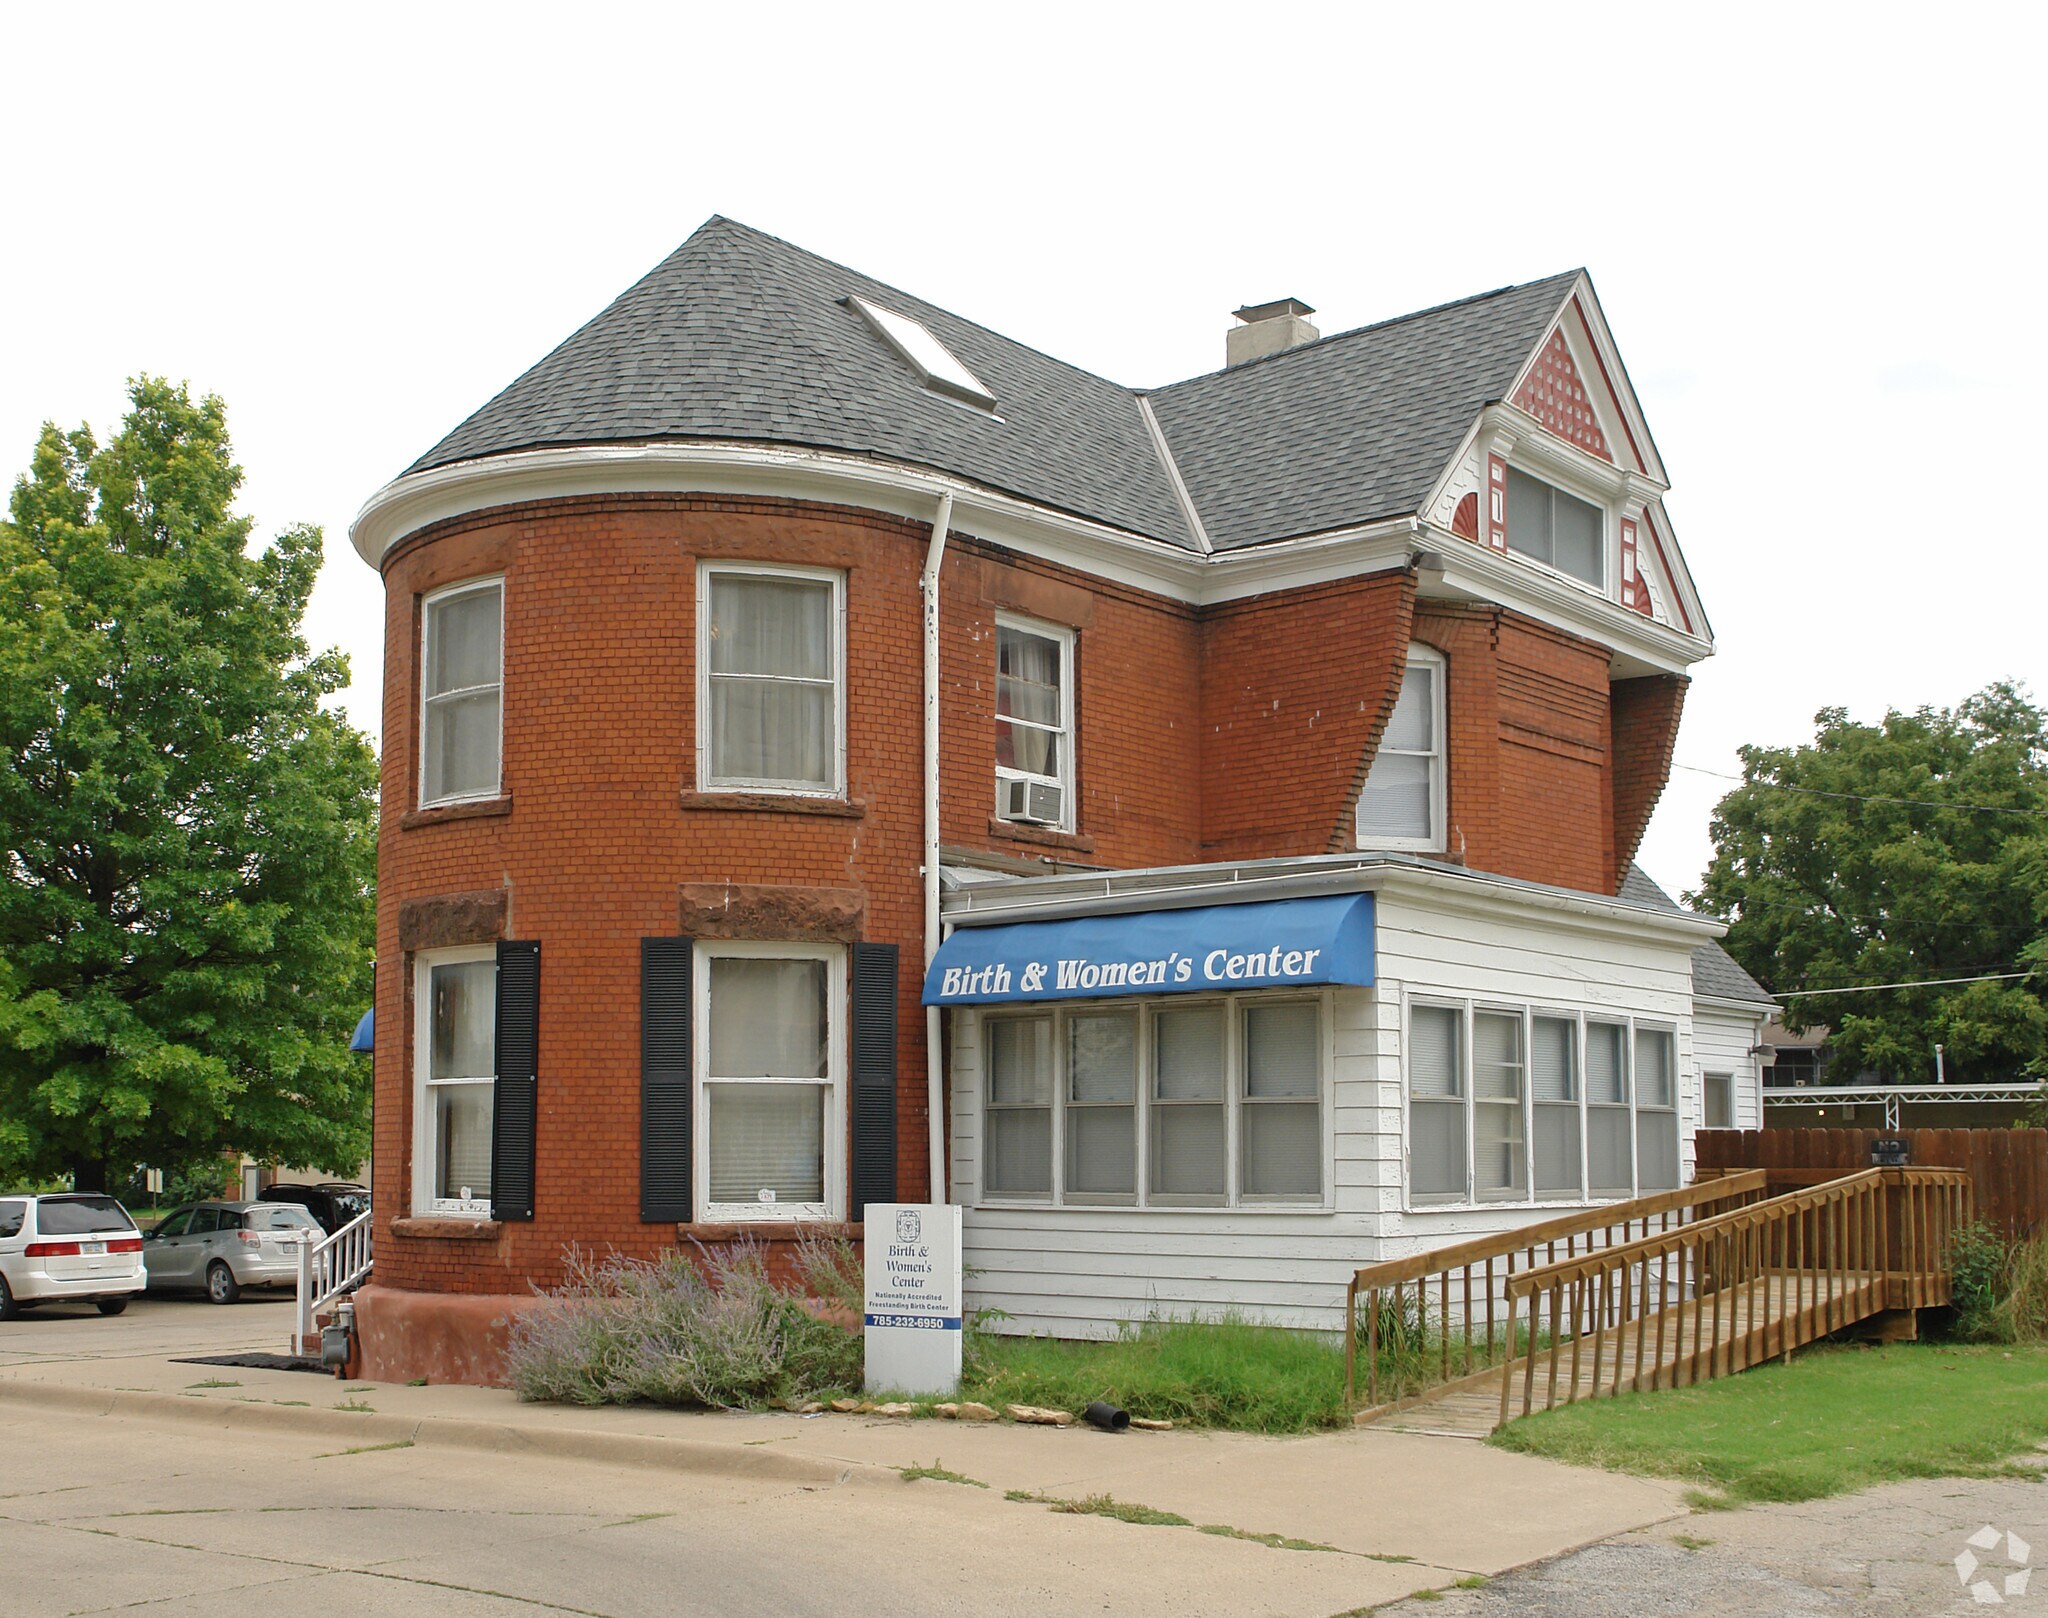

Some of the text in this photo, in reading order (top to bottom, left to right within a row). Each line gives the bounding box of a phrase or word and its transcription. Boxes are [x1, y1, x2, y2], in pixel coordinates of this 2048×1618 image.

[940, 944, 1321, 996] Birth & Women's Center
[888, 1244, 930, 1258] Birth &
[886, 1260, 932, 1273] Women's
[892, 1275, 925, 1288] Center
[875, 1292, 942, 1301] Nationally Accredited
[869, 1301, 949, 1311] Freestanding Birth Center
